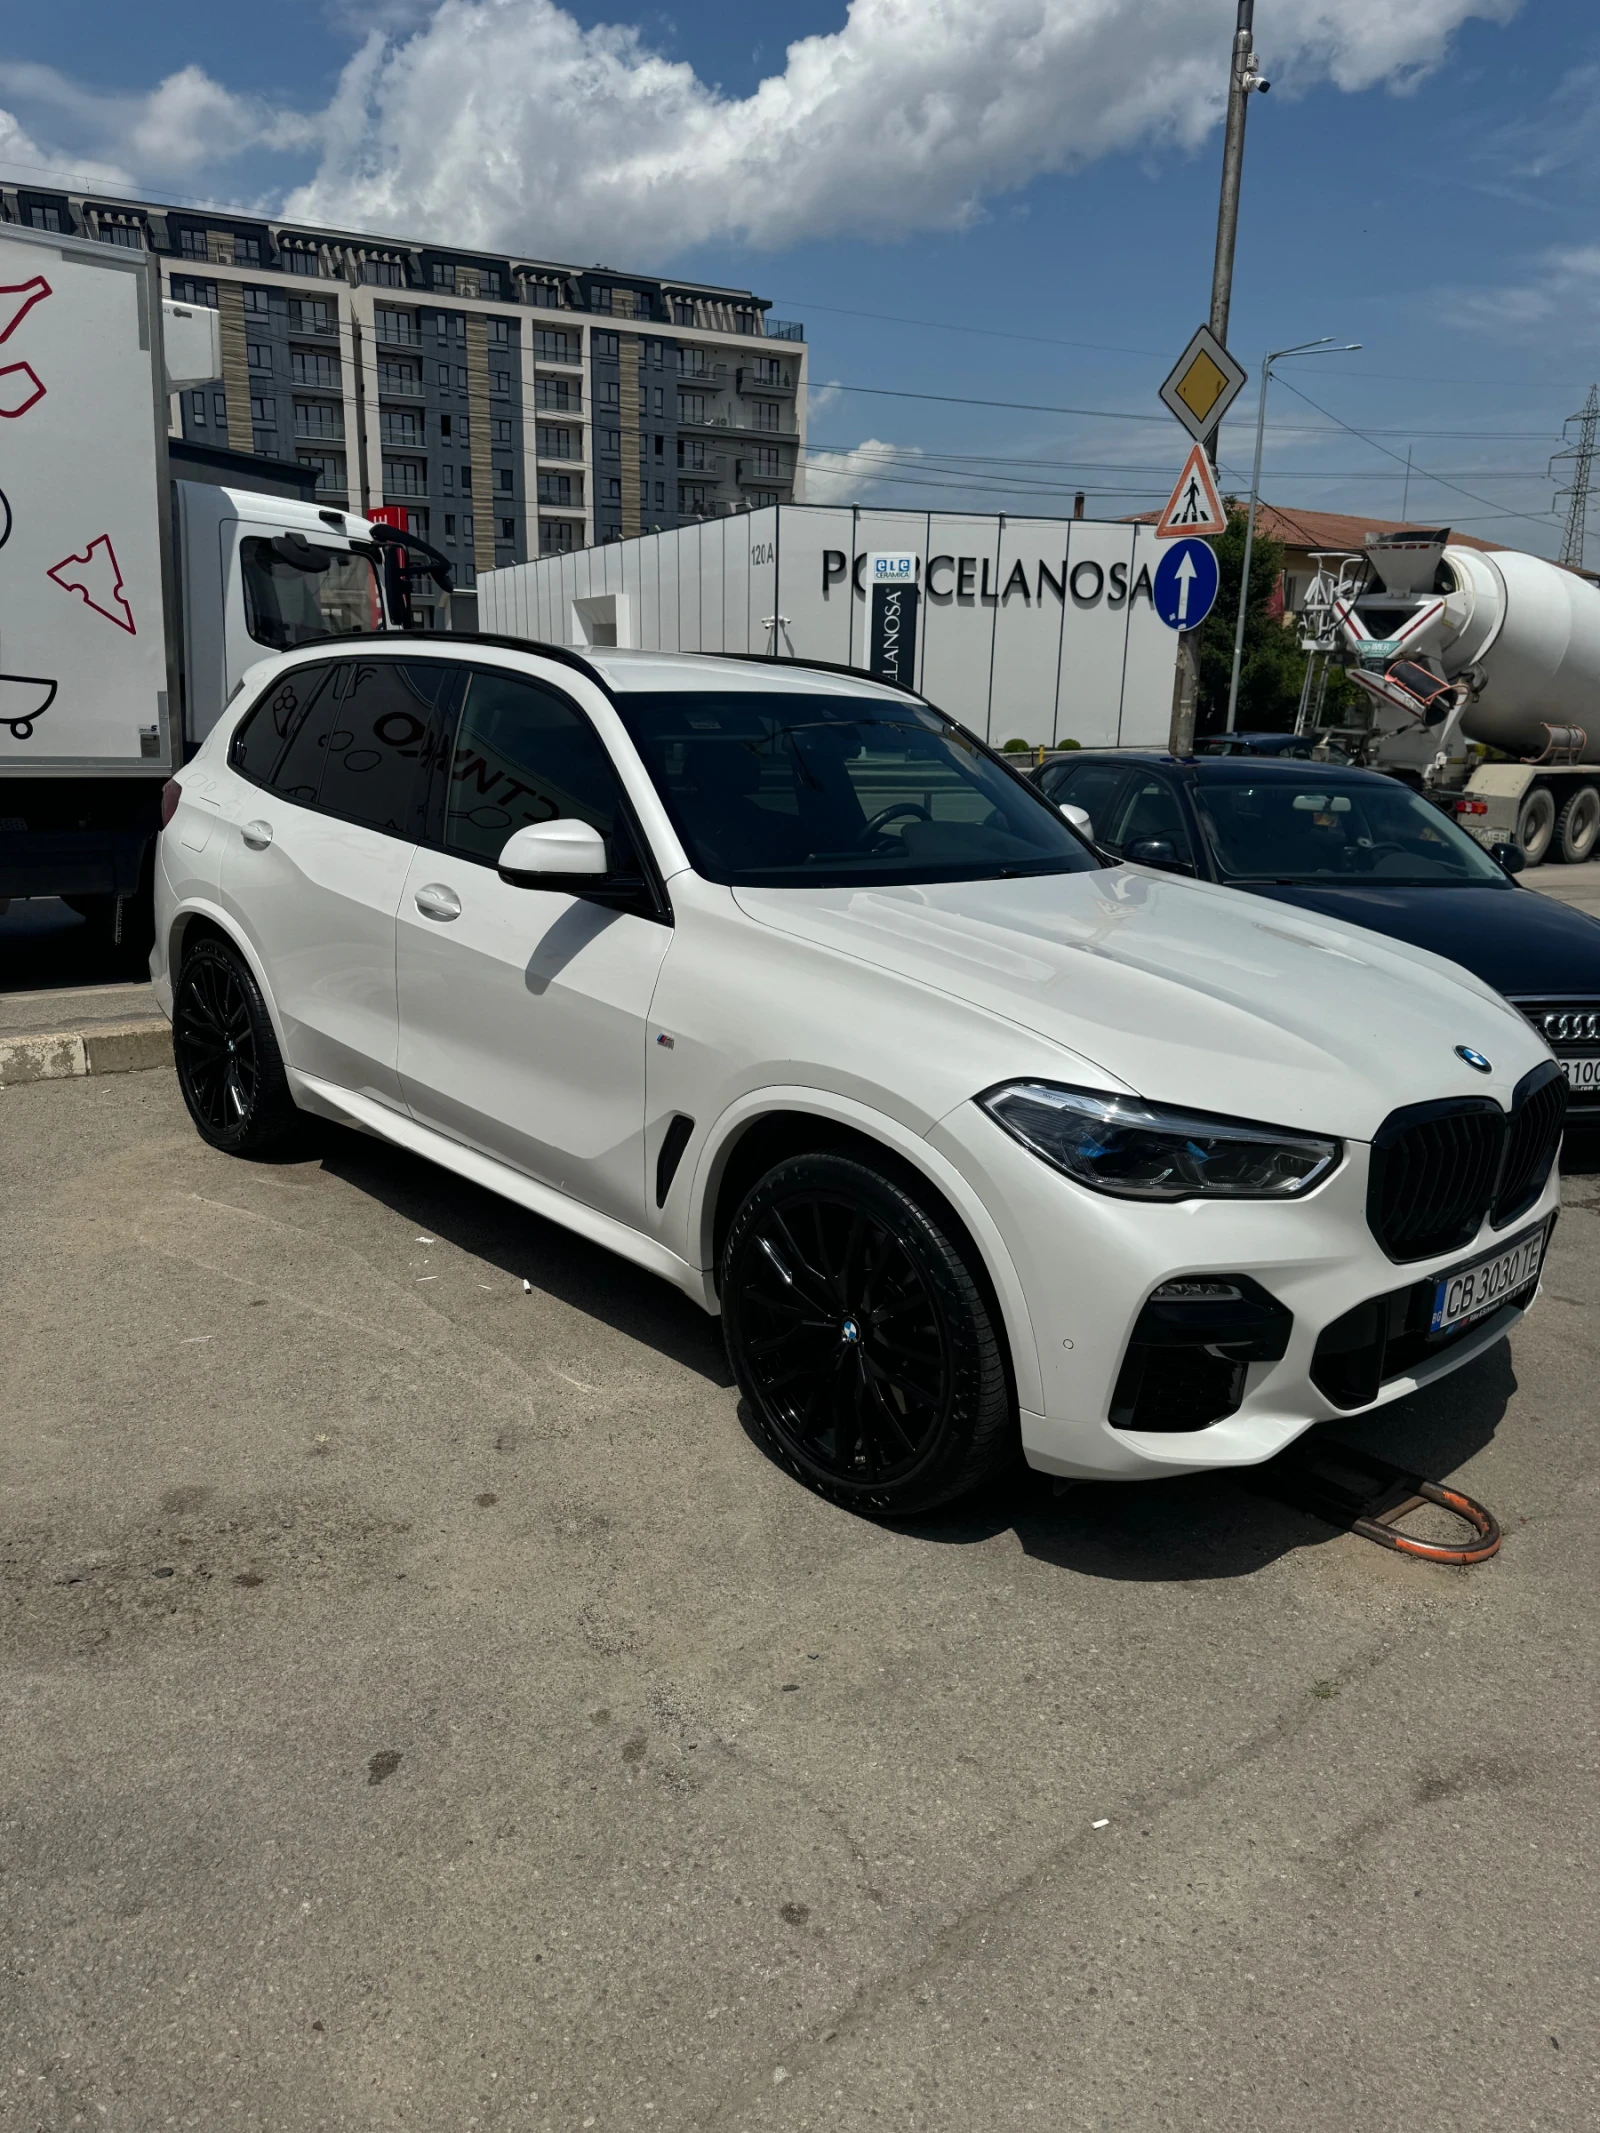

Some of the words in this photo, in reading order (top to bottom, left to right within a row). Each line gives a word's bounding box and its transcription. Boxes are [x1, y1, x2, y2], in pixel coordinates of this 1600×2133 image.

[822, 549, 1154, 601] PCELANOSA
[876, 571, 910, 579] CERAMICA
[1447, 1274, 1475, 1318] CB
[1476, 1250, 1519, 1304] 3030
[1521, 1234, 1541, 1279] TE
